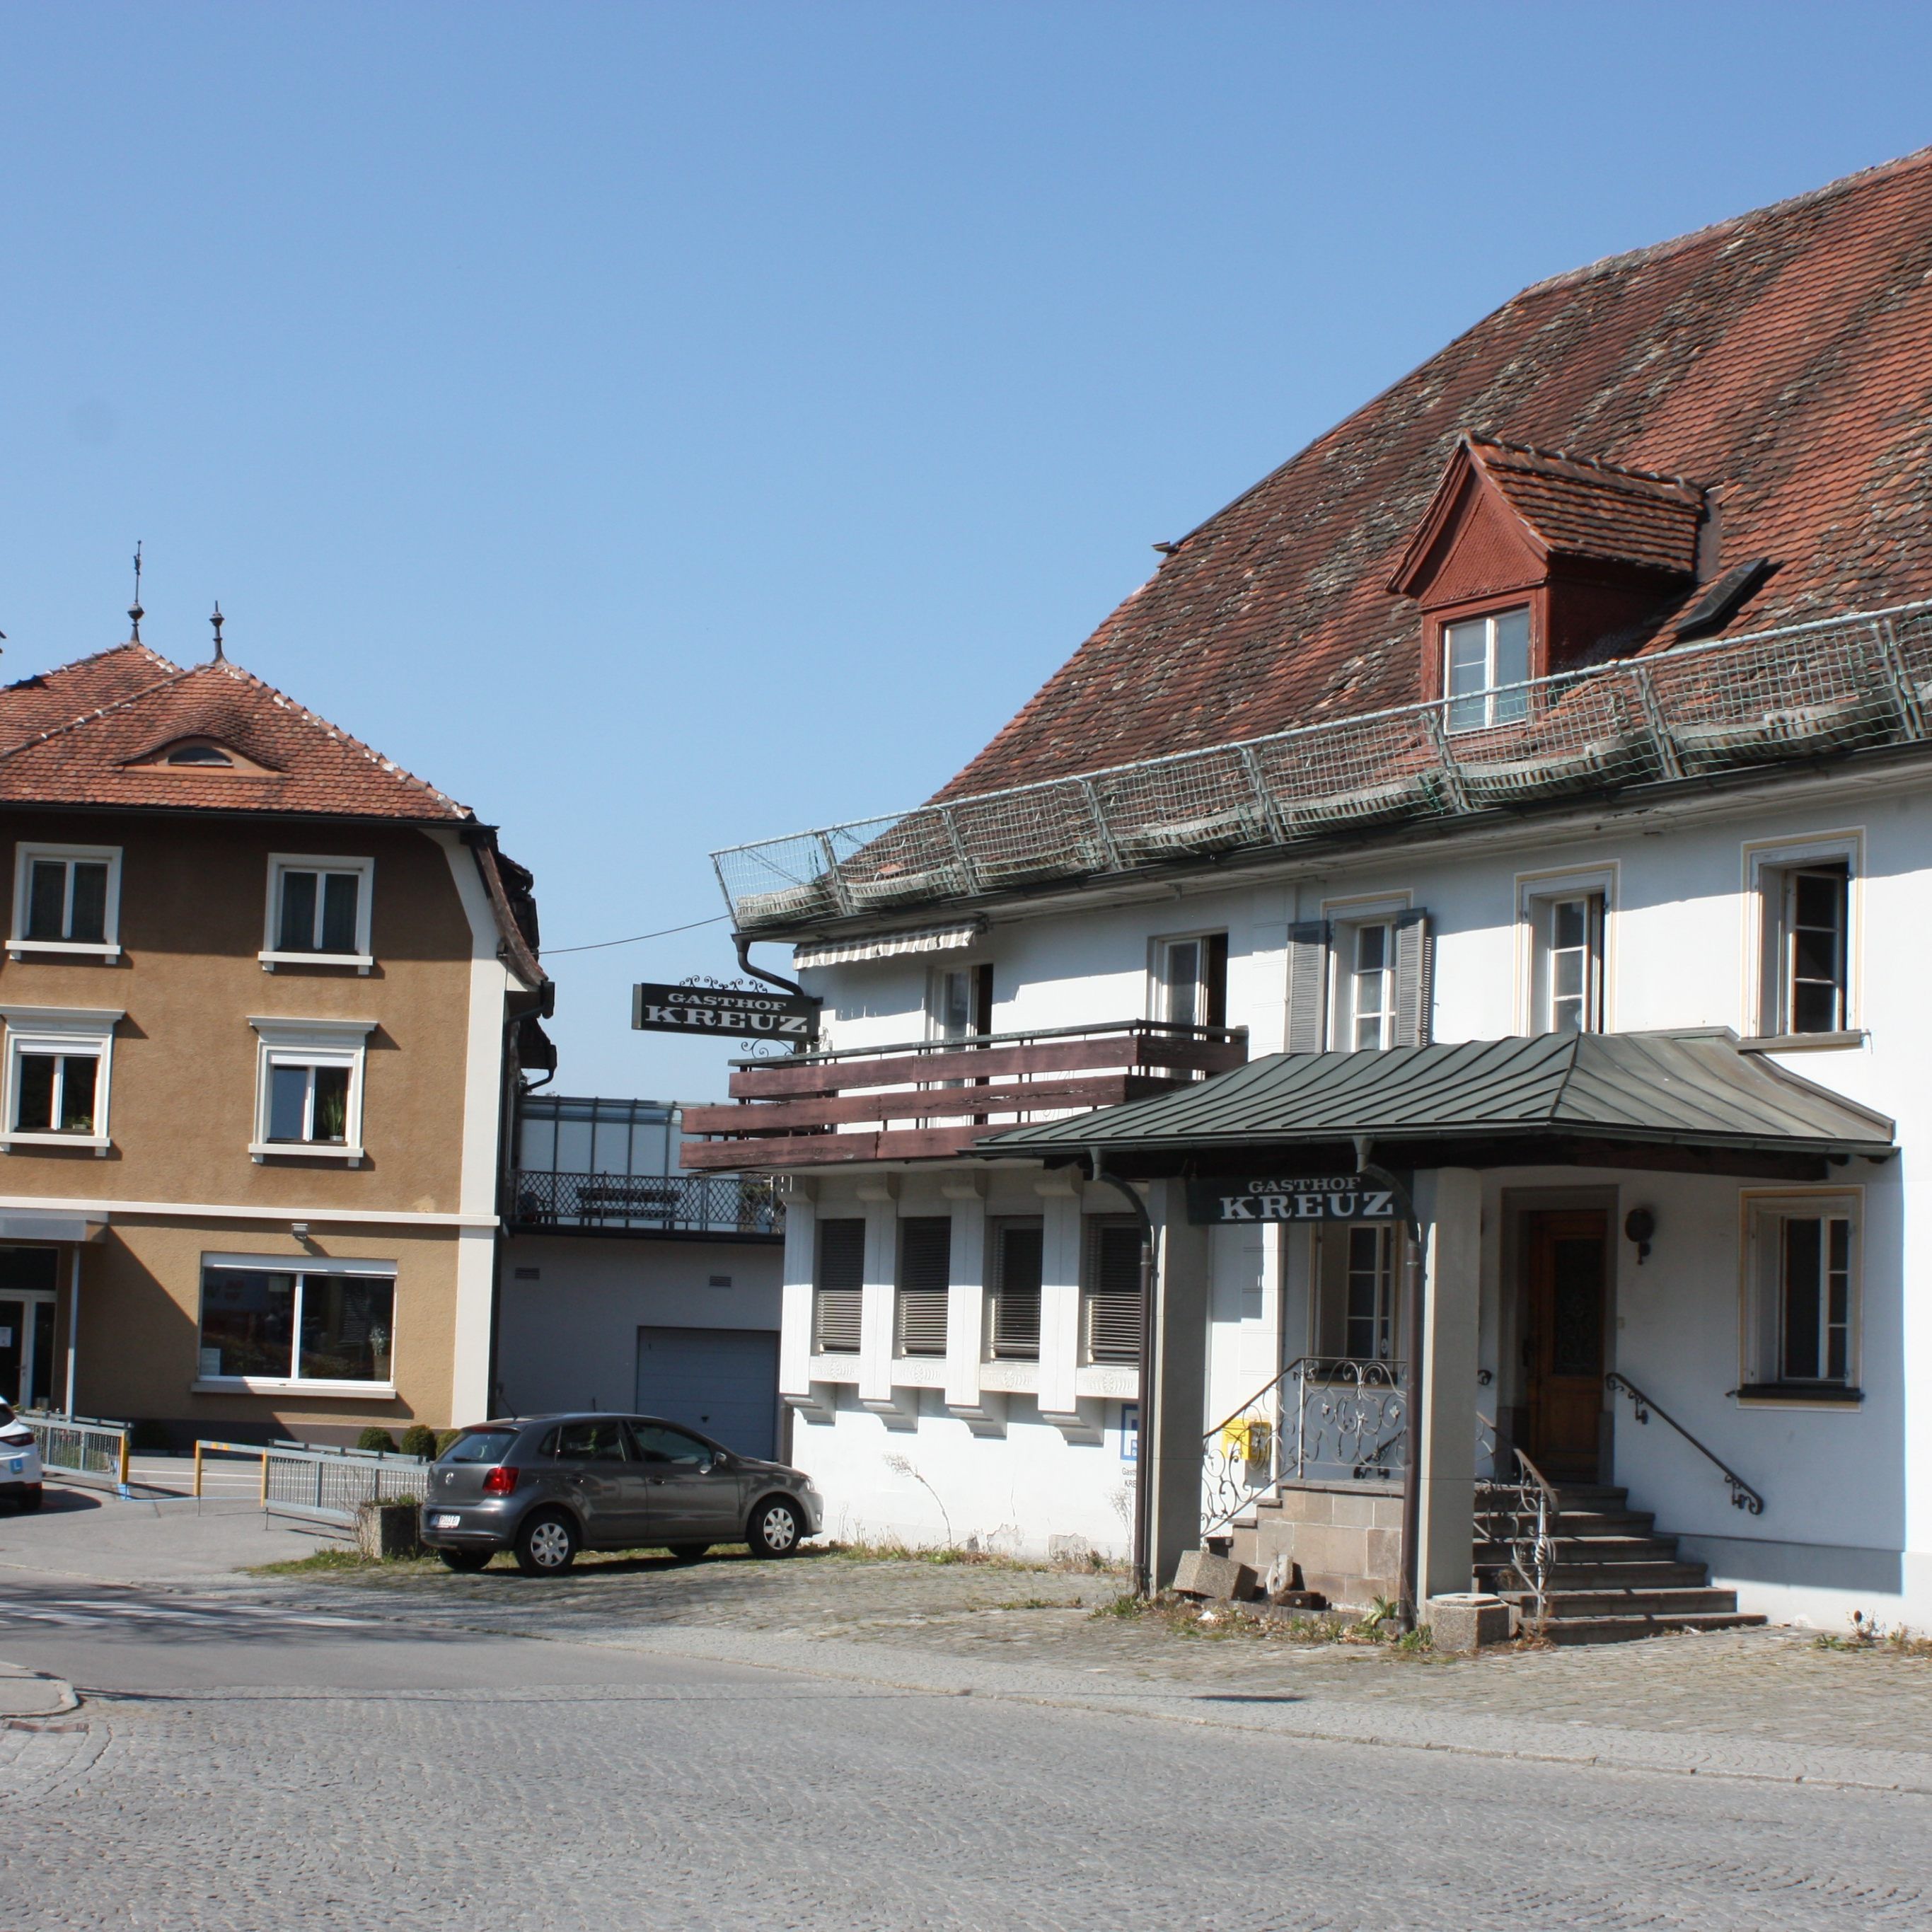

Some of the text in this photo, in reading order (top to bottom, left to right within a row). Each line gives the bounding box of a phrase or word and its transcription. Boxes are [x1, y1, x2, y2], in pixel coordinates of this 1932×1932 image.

[668, 993, 787, 1011] GASTHOF
[645, 1005, 807, 1034] KREUZ
[1248, 1176, 1361, 1193] GASTHOF
[1219, 1191, 1394, 1220] KREUZ
[1125, 1479, 1137, 1488] KRE
